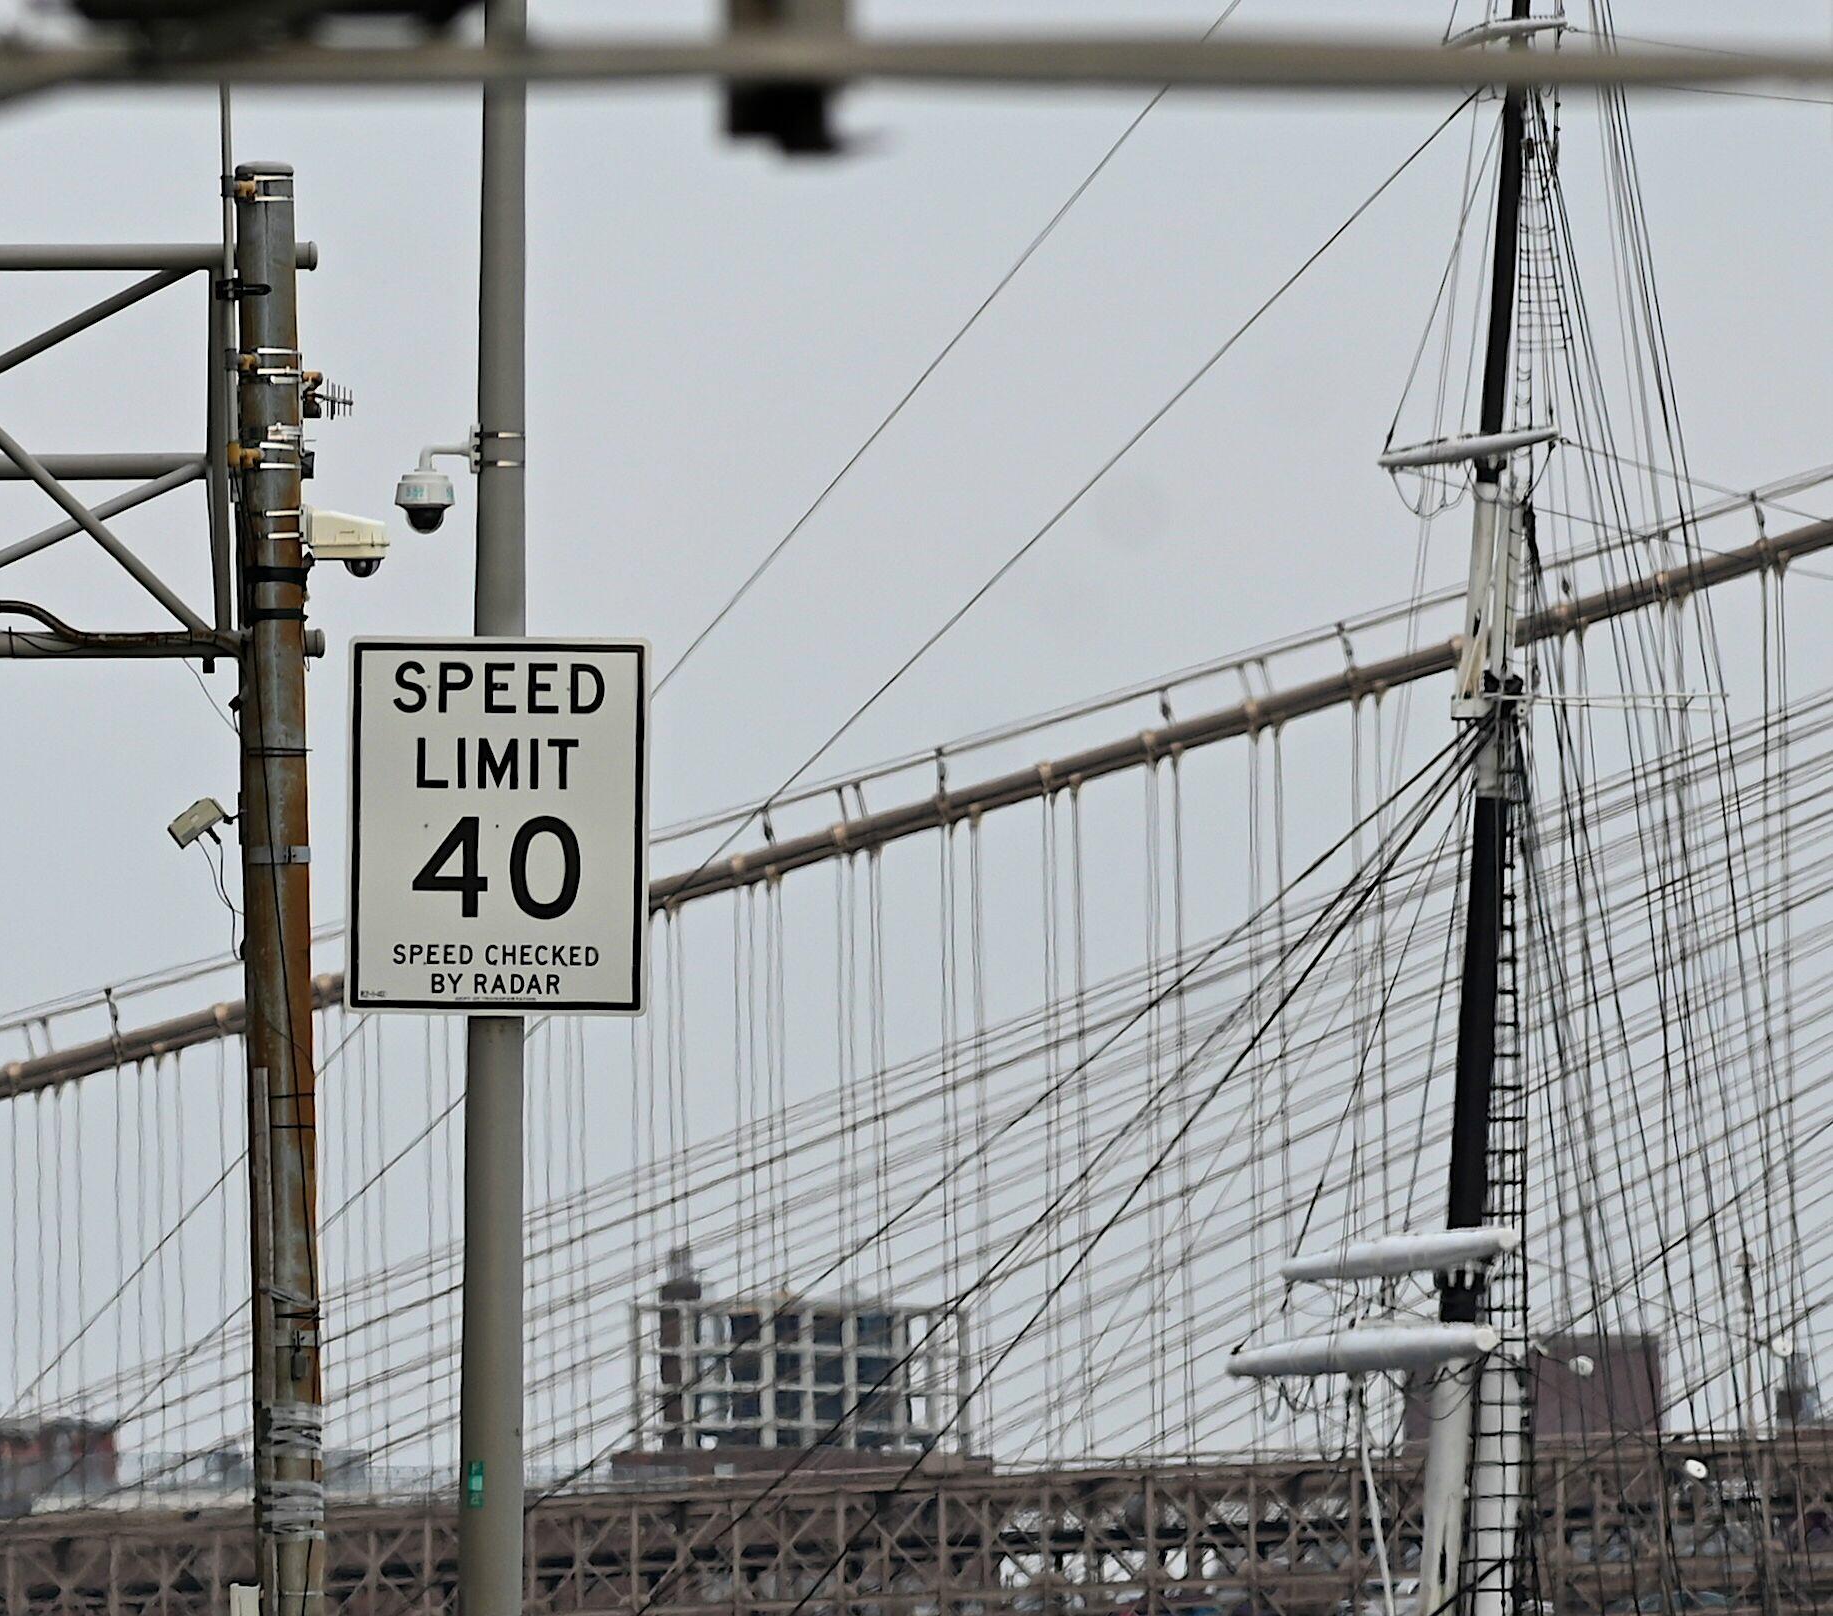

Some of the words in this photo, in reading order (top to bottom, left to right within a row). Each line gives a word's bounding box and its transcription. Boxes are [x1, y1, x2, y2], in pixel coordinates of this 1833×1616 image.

[394, 661, 605, 714] SPEED
[417, 738, 579, 789] LIMIT
[412, 816, 580, 919] 40
[393, 944, 473, 964] SPEED
[486, 945, 598, 966] CHECKED
[432, 973, 463, 993] BY
[474, 974, 559, 994] RADAR
